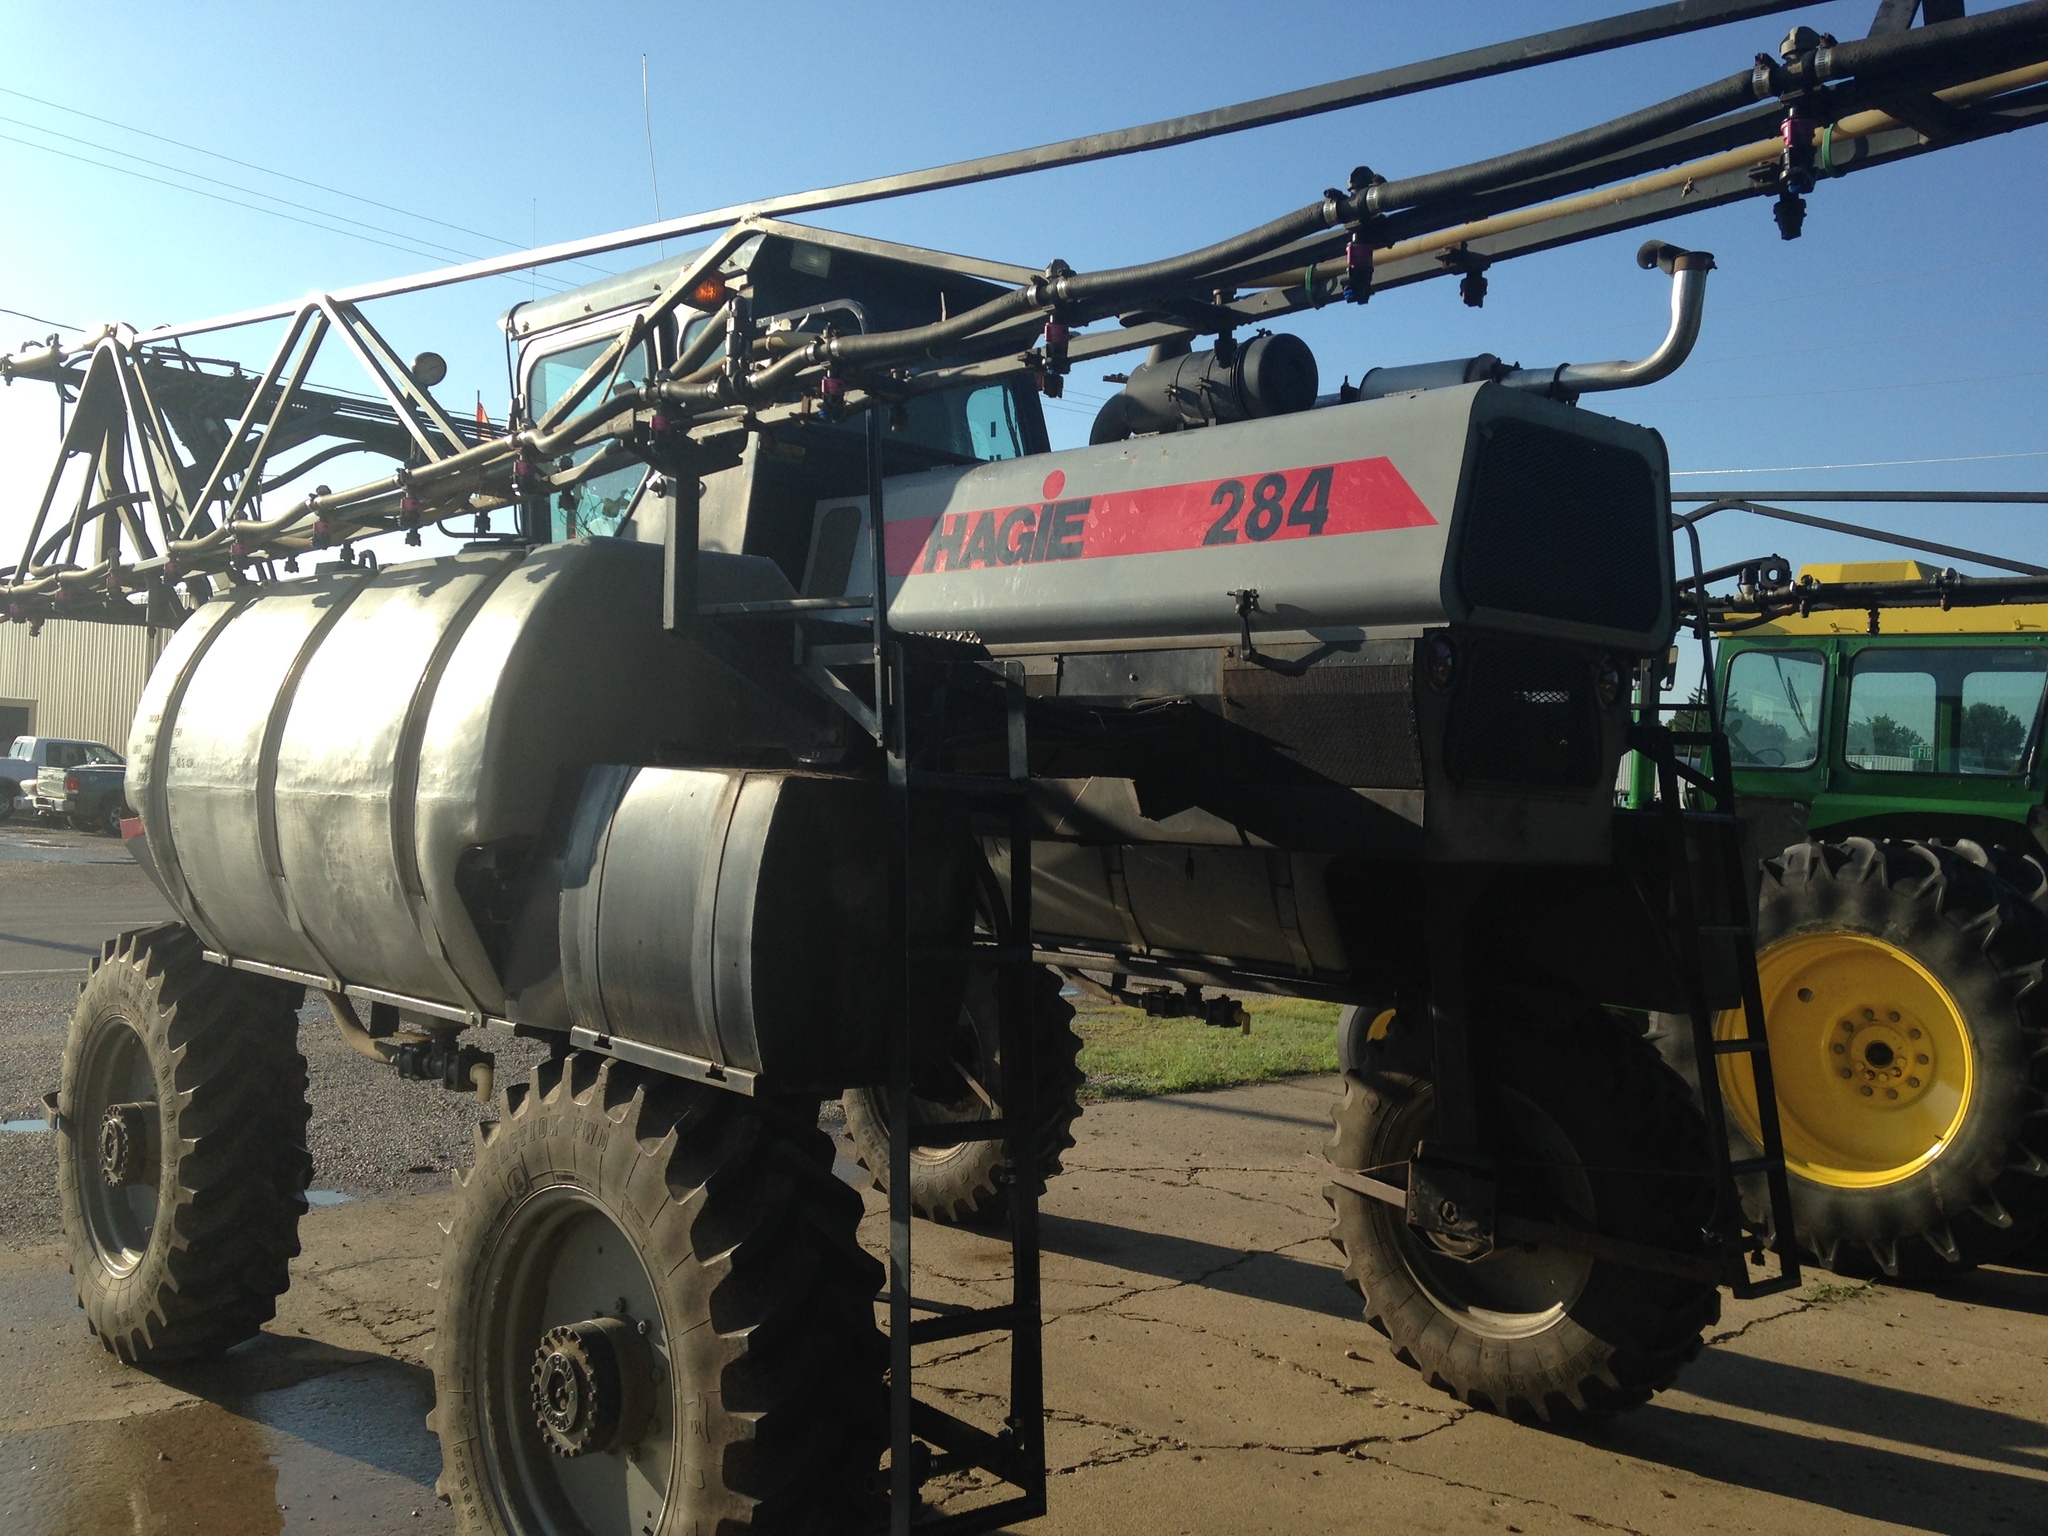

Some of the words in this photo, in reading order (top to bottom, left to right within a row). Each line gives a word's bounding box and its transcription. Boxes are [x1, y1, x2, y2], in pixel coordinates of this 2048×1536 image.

[922, 498, 1092, 573] HAGIE
[1202, 466, 1334, 546] 284
[478, 1113, 563, 1189] TRACTION
[572, 1116, 610, 1153] FWD
